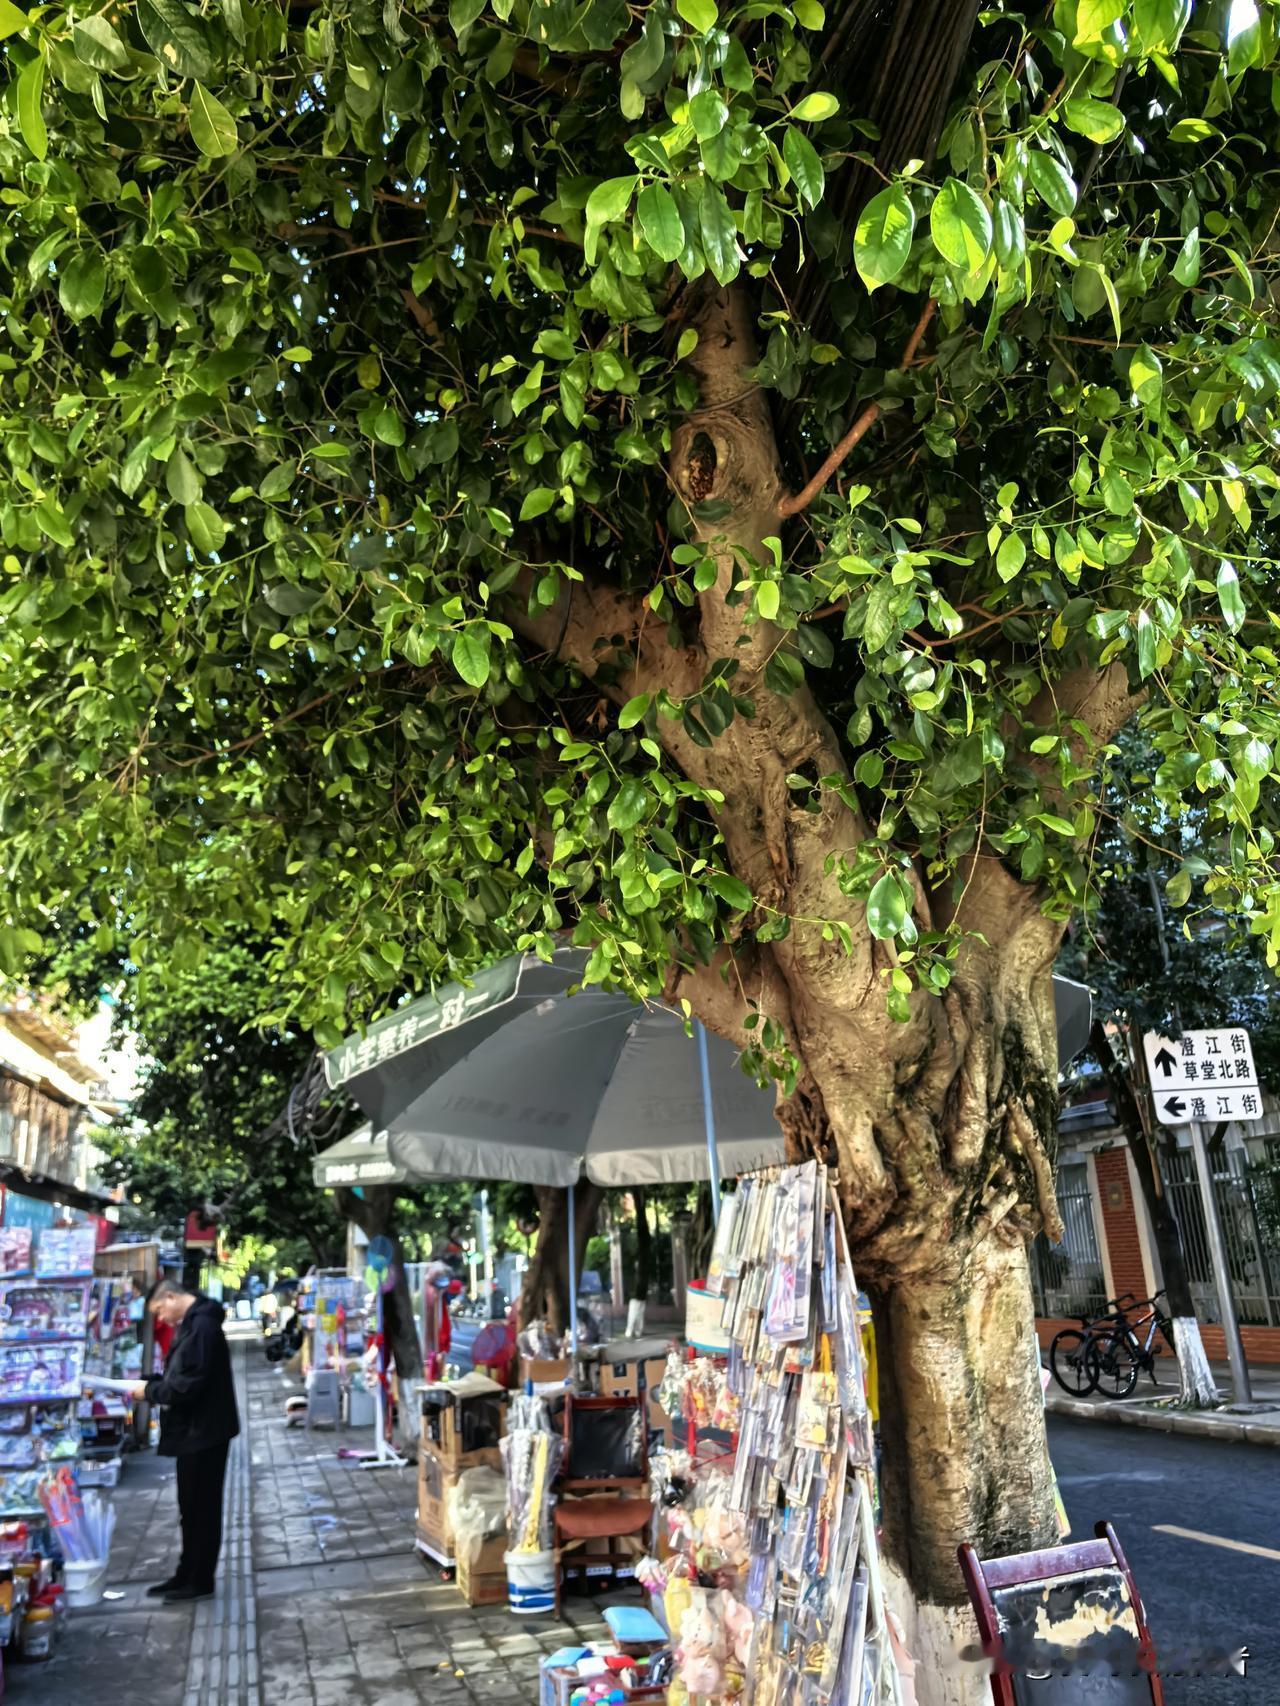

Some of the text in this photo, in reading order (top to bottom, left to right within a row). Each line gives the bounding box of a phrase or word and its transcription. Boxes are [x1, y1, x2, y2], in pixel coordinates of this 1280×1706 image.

[1180, 1034, 1246, 1056] 澄江街
[1183, 1058, 1250, 1081] 草堂北路
[1190, 1094, 1257, 1117] 澄江街
